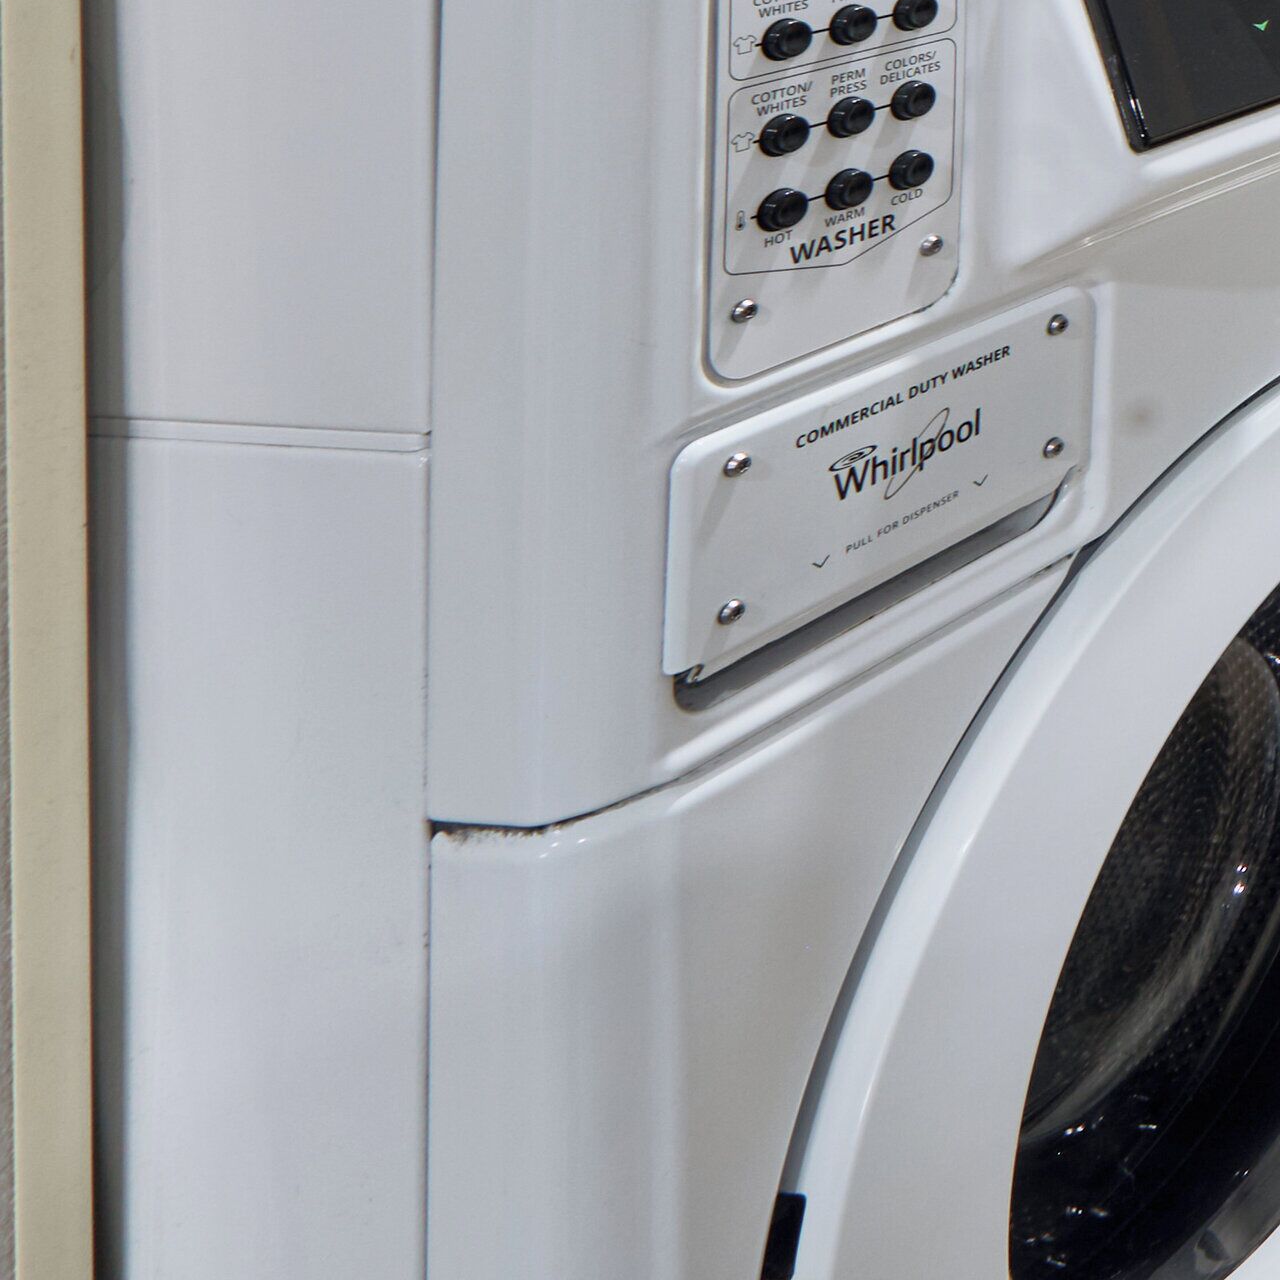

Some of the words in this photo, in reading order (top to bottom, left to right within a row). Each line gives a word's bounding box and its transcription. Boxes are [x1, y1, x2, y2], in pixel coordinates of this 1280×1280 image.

[758, 0, 809, 19] WHITES
[885, 51, 937, 71] COLORS/
[831, 68, 866, 85] PERM
[880, 61, 941, 85] DELICATES
[751, 81, 813, 105] COTTON/
[830, 80, 867, 98] PRESS
[756, 94, 807, 117] WHITES
[890, 188, 923, 206] COLD
[824, 207, 865, 227] WARM
[764, 230, 793, 248] HOT
[790, 214, 896, 264] WASHER
[796, 392, 904, 449] COMMERCIAL
[908, 372, 949, 400] DUTY
[951, 346, 1011, 380] WASHER
[833, 408, 982, 501] Whirlpool
[846, 535, 873, 554] PULL
[877, 521, 899, 538] FOR
[902, 490, 960, 525] DISPENSER
